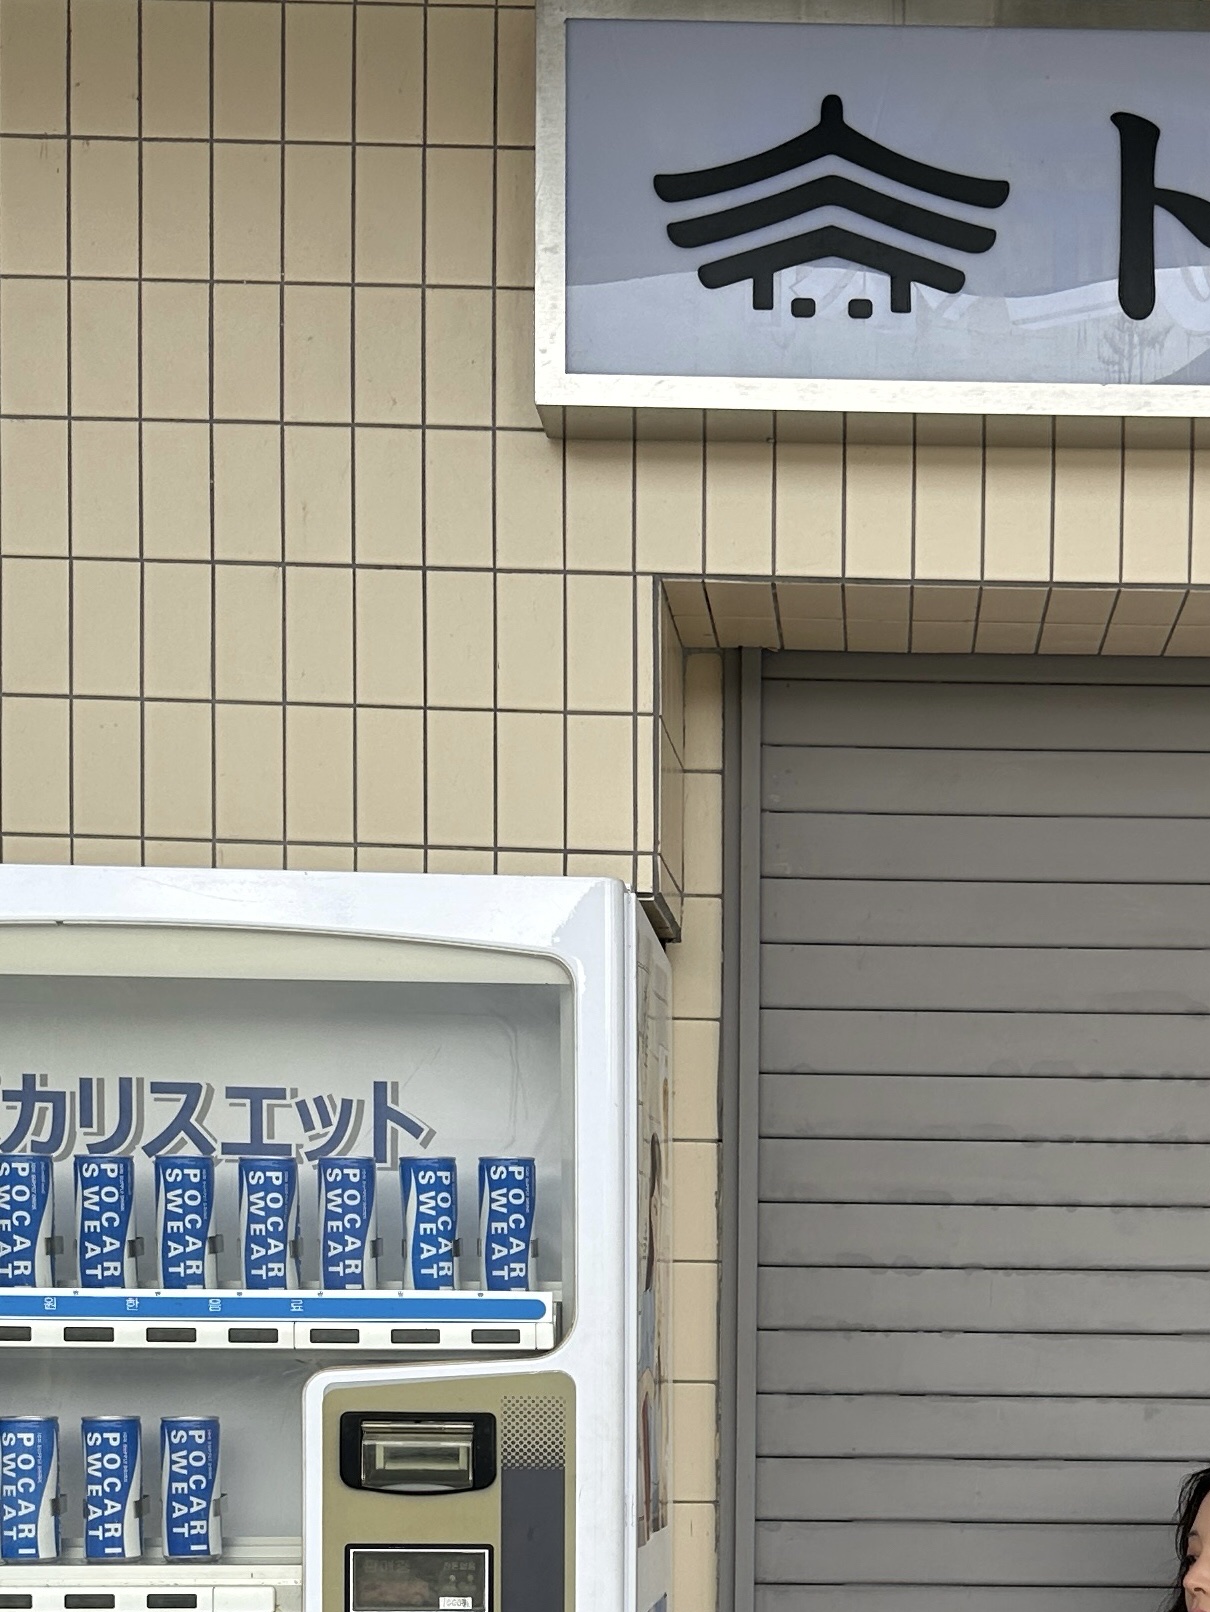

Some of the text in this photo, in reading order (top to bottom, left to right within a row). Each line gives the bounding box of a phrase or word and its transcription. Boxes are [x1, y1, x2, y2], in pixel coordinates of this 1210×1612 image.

[82, 1163, 102, 1280] SWEAT
[165, 1168, 185, 1277] SWEAT
[248, 1171, 267, 1280] SWEAT
[326, 1168, 344, 1277] SWEAT
[418, 1170, 438, 1279] SWEAT
[490, 1165, 509, 1281] SWEAT
[2, 1432, 17, 1541] SWEAT
[17, 1432, 36, 1554] POCARI
[87, 1432, 103, 1541] SWEAT
[102, 1432, 122, 1554] POCARI
[171, 1430, 189, 1538] SWEAT
[189, 1429, 208, 1551] POCARI
